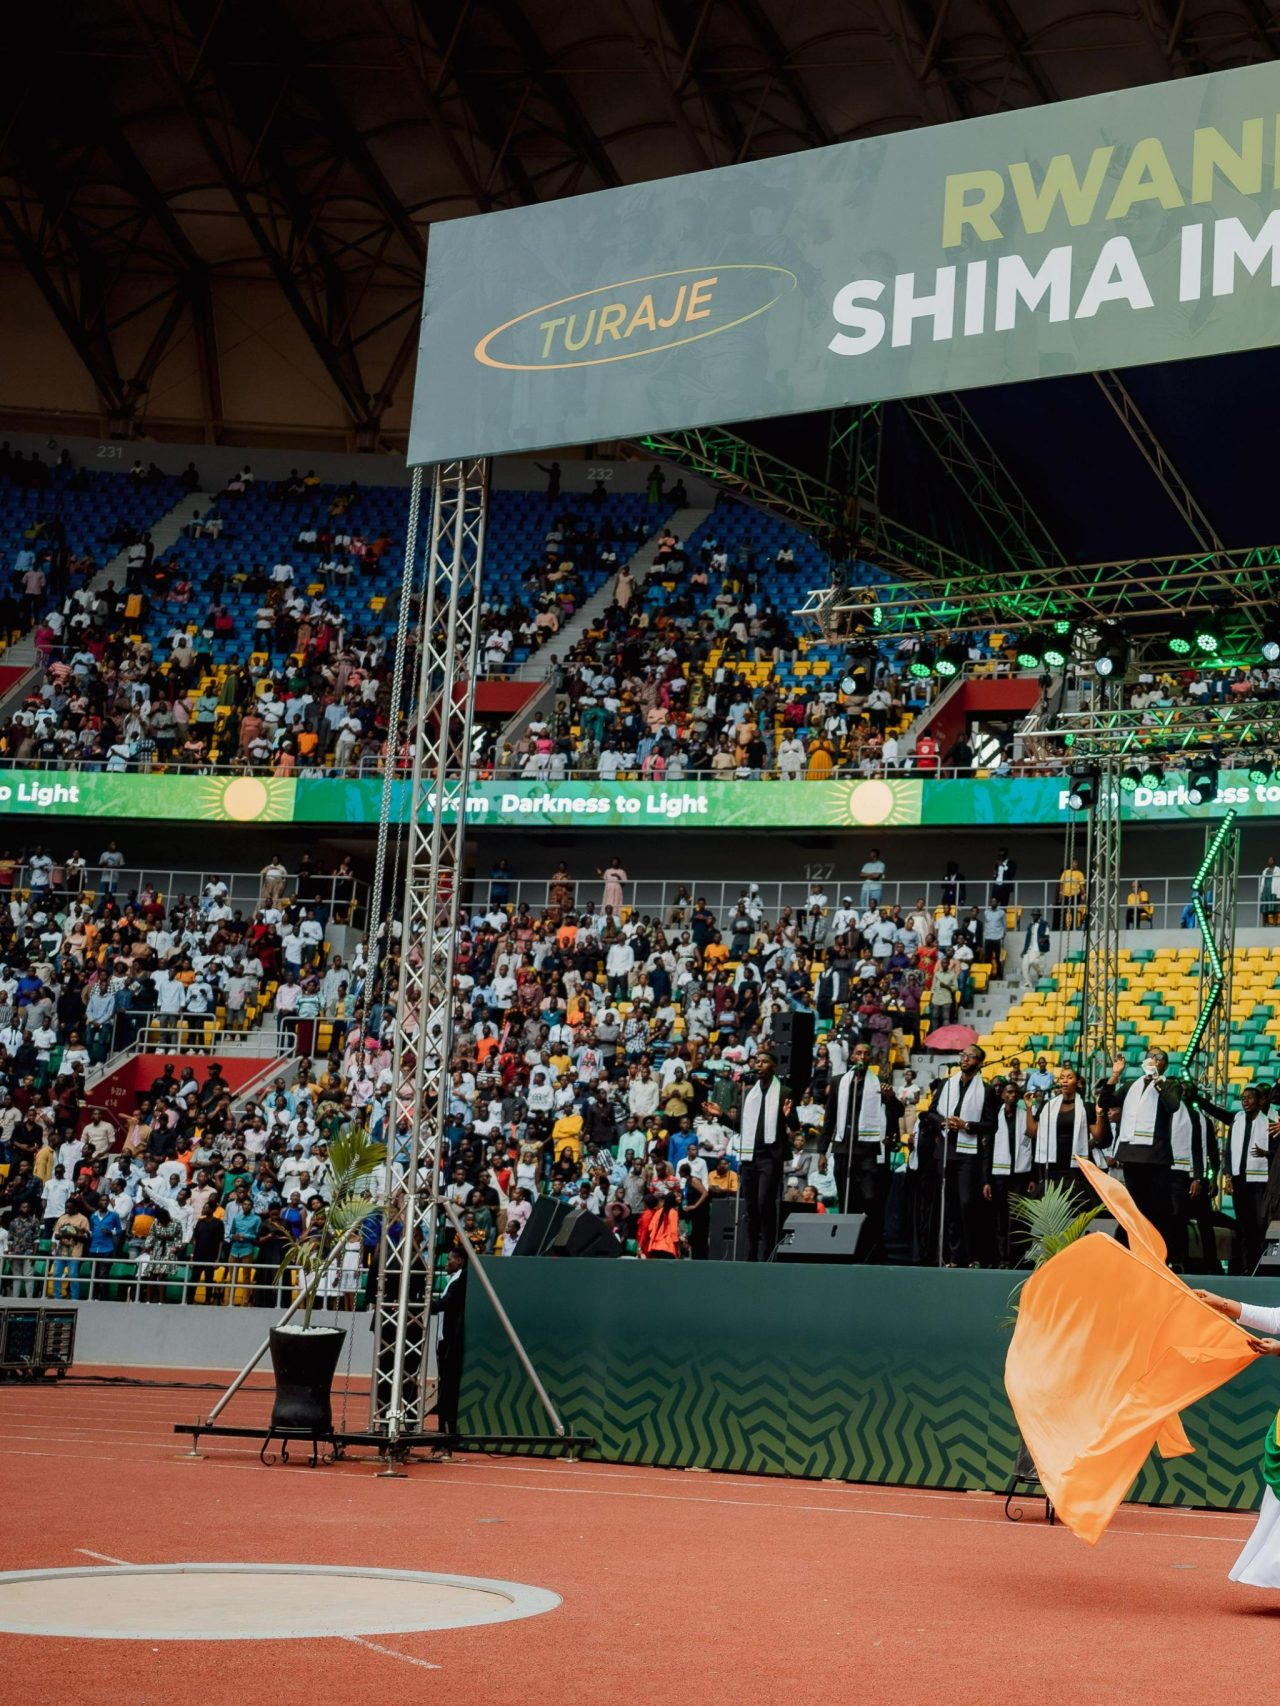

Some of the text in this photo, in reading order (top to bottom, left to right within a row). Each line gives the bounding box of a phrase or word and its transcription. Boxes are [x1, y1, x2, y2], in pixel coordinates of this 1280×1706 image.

[826, 235, 1155, 357] SHIMA
[539, 276, 719, 359] TURAJE
[97, 445, 122, 459] 231
[586, 468, 614, 480] 232
[17, 782, 80, 807] Light
[501, 793, 611, 814] Darkness
[615, 794, 641, 814] to
[646, 792, 708, 818] Light
[1134, 783, 1250, 808] Darkess
[803, 863, 836, 880] 127
